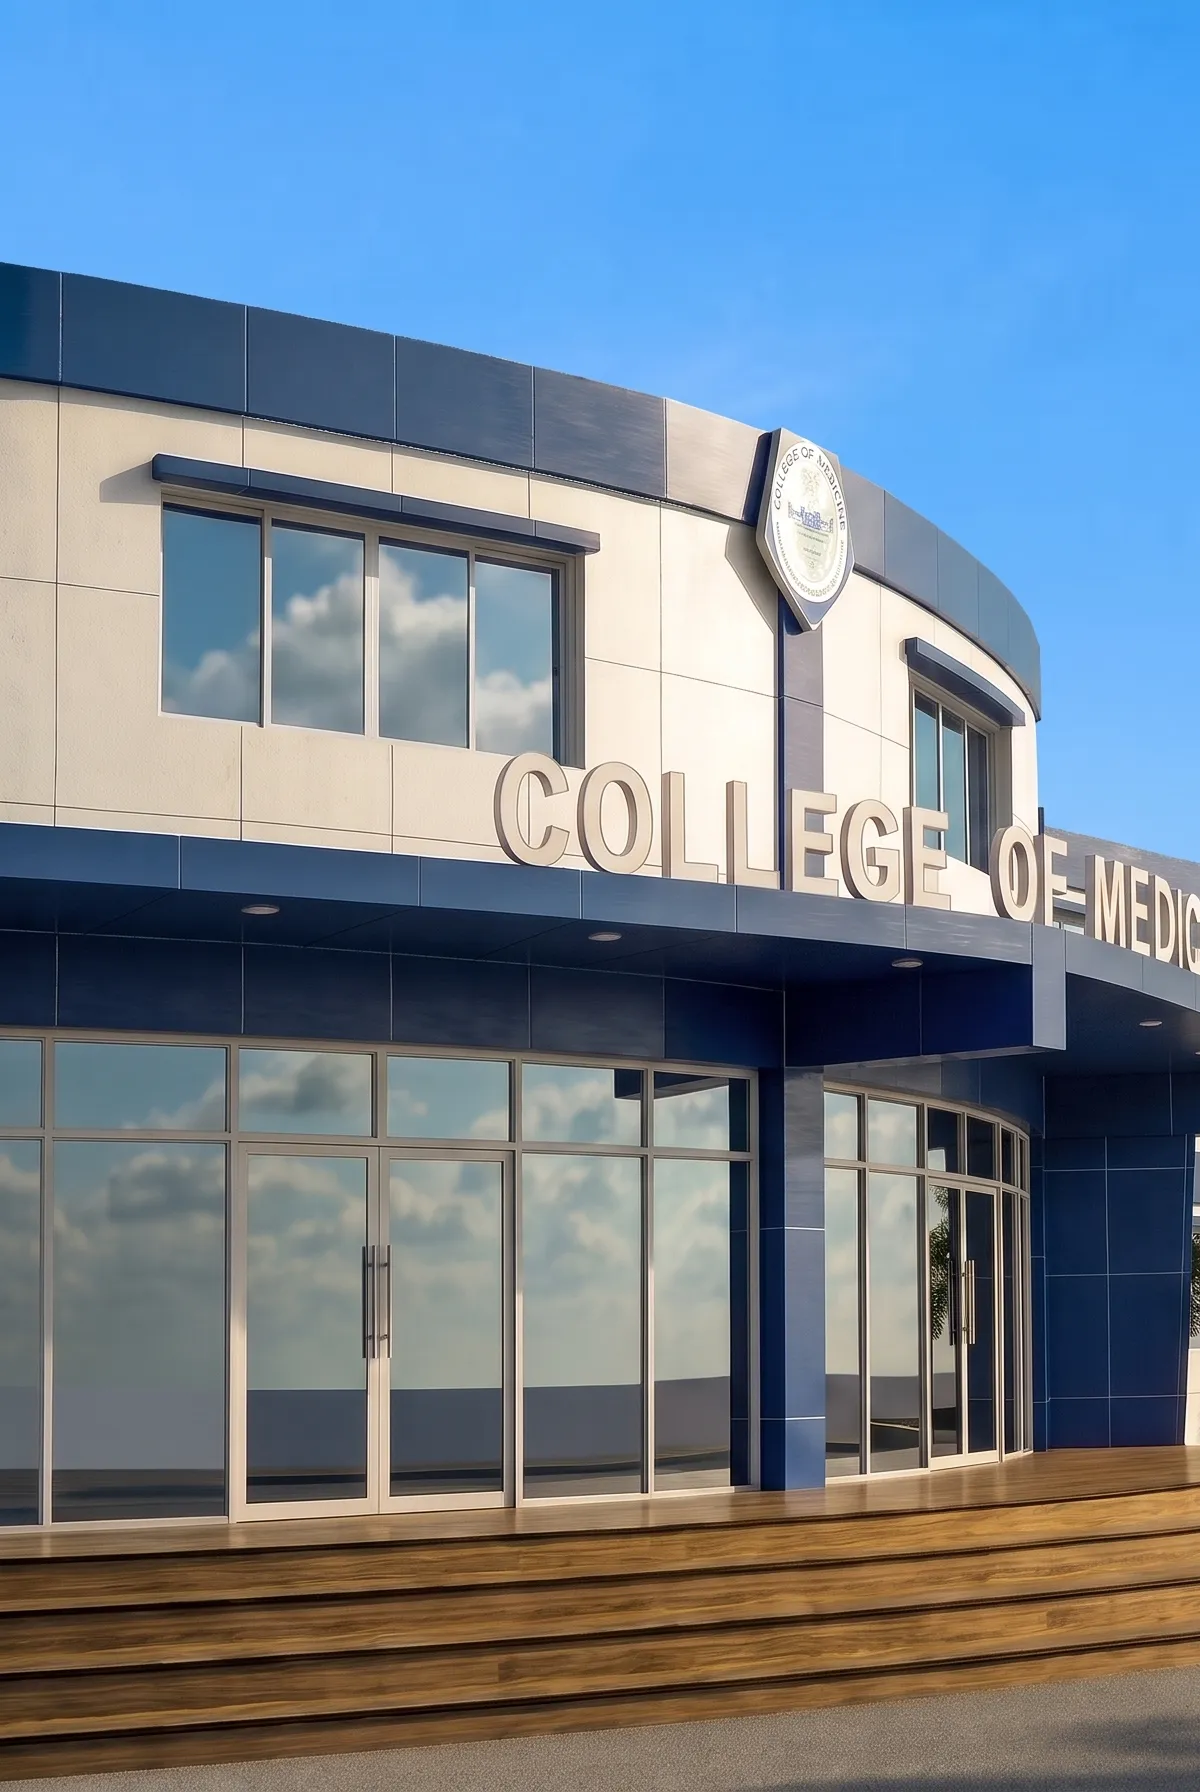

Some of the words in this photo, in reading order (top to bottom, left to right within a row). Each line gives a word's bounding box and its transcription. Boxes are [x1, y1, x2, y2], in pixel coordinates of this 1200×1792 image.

[774, 448, 800, 510] COLLEGE
[800, 446, 815, 460] OF
[816, 455, 846, 531] MEDICINE
[493, 752, 952, 911] COLLEGE
[989, 825, 1068, 927] OF
